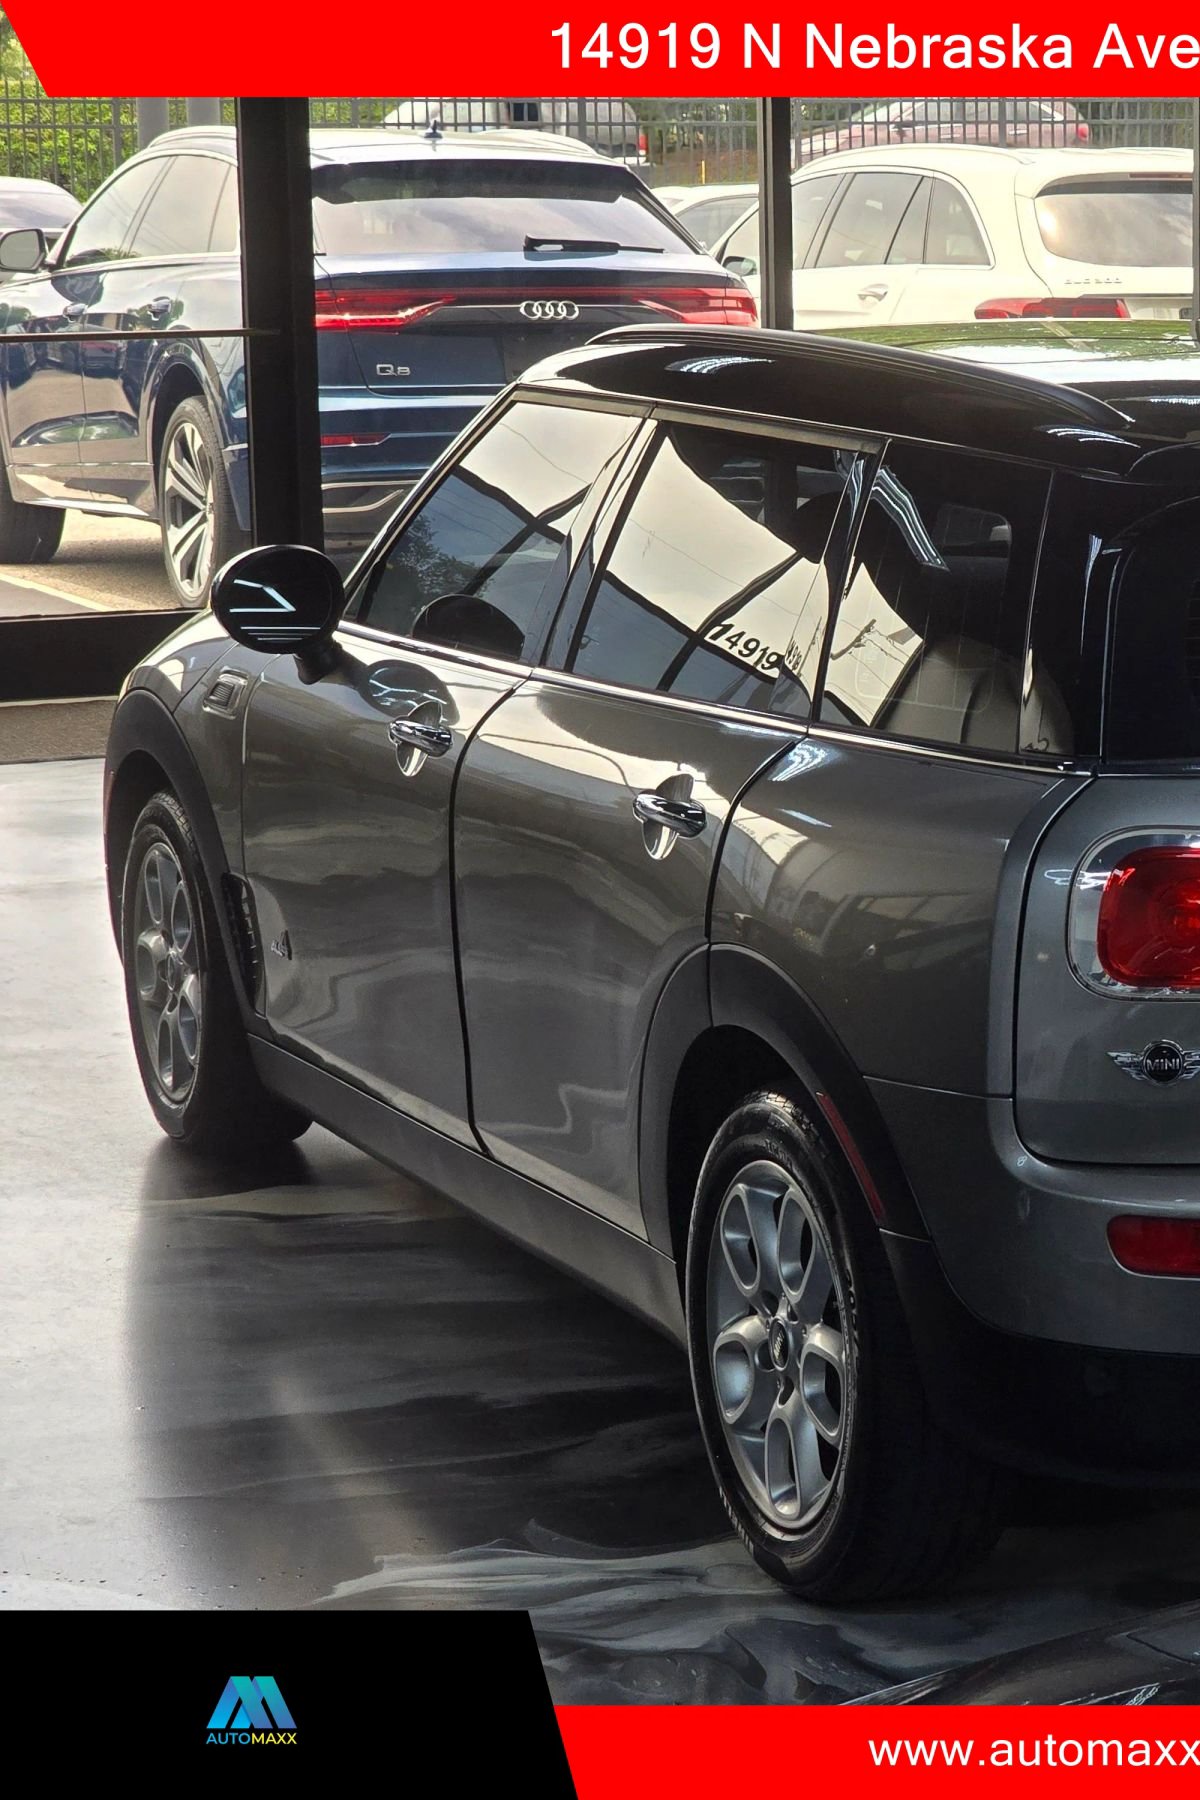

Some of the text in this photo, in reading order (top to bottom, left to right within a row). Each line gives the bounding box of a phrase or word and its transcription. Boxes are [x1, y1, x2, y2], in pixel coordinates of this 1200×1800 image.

[376, 363, 411, 376] Q8
[708, 622, 785, 670] 14919
[1145, 1058, 1181, 1071] MINI
